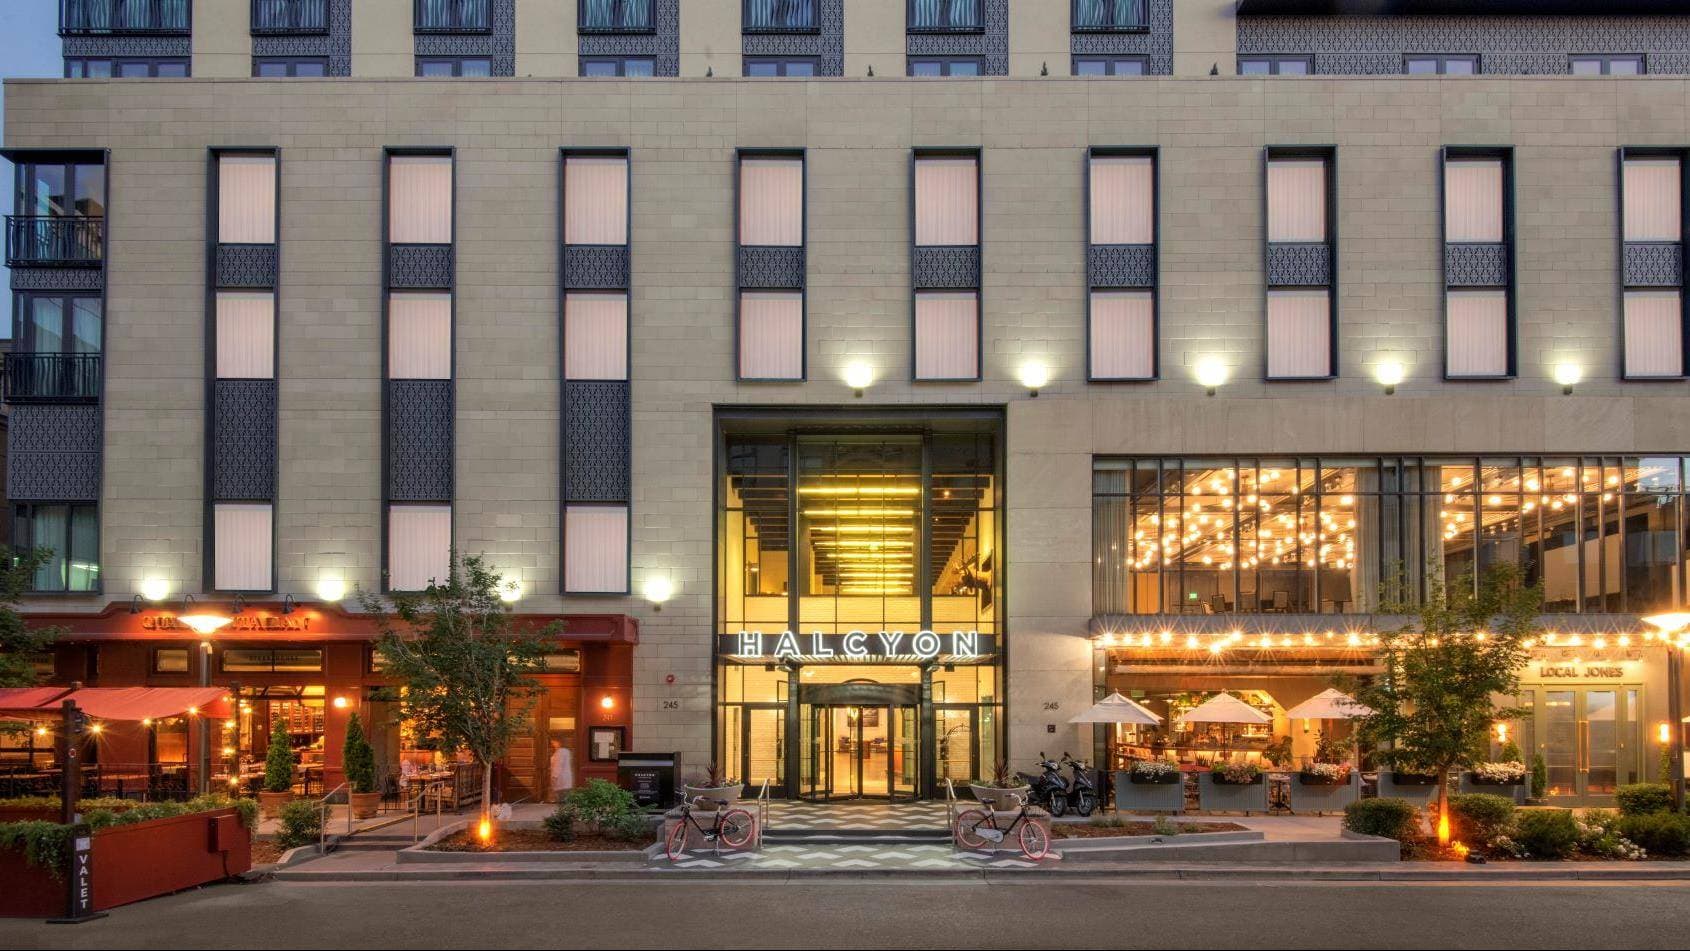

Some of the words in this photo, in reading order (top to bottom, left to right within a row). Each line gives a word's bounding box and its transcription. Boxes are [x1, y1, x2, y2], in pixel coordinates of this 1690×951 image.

[738, 631, 978, 658] HALCYON
[1540, 667, 1578, 678] LOCAL
[1584, 667, 1623, 678] JONES
[664, 701, 678, 709] 245
[1043, 701, 1060, 710] 245
[79, 854, 88, 909] VALET
